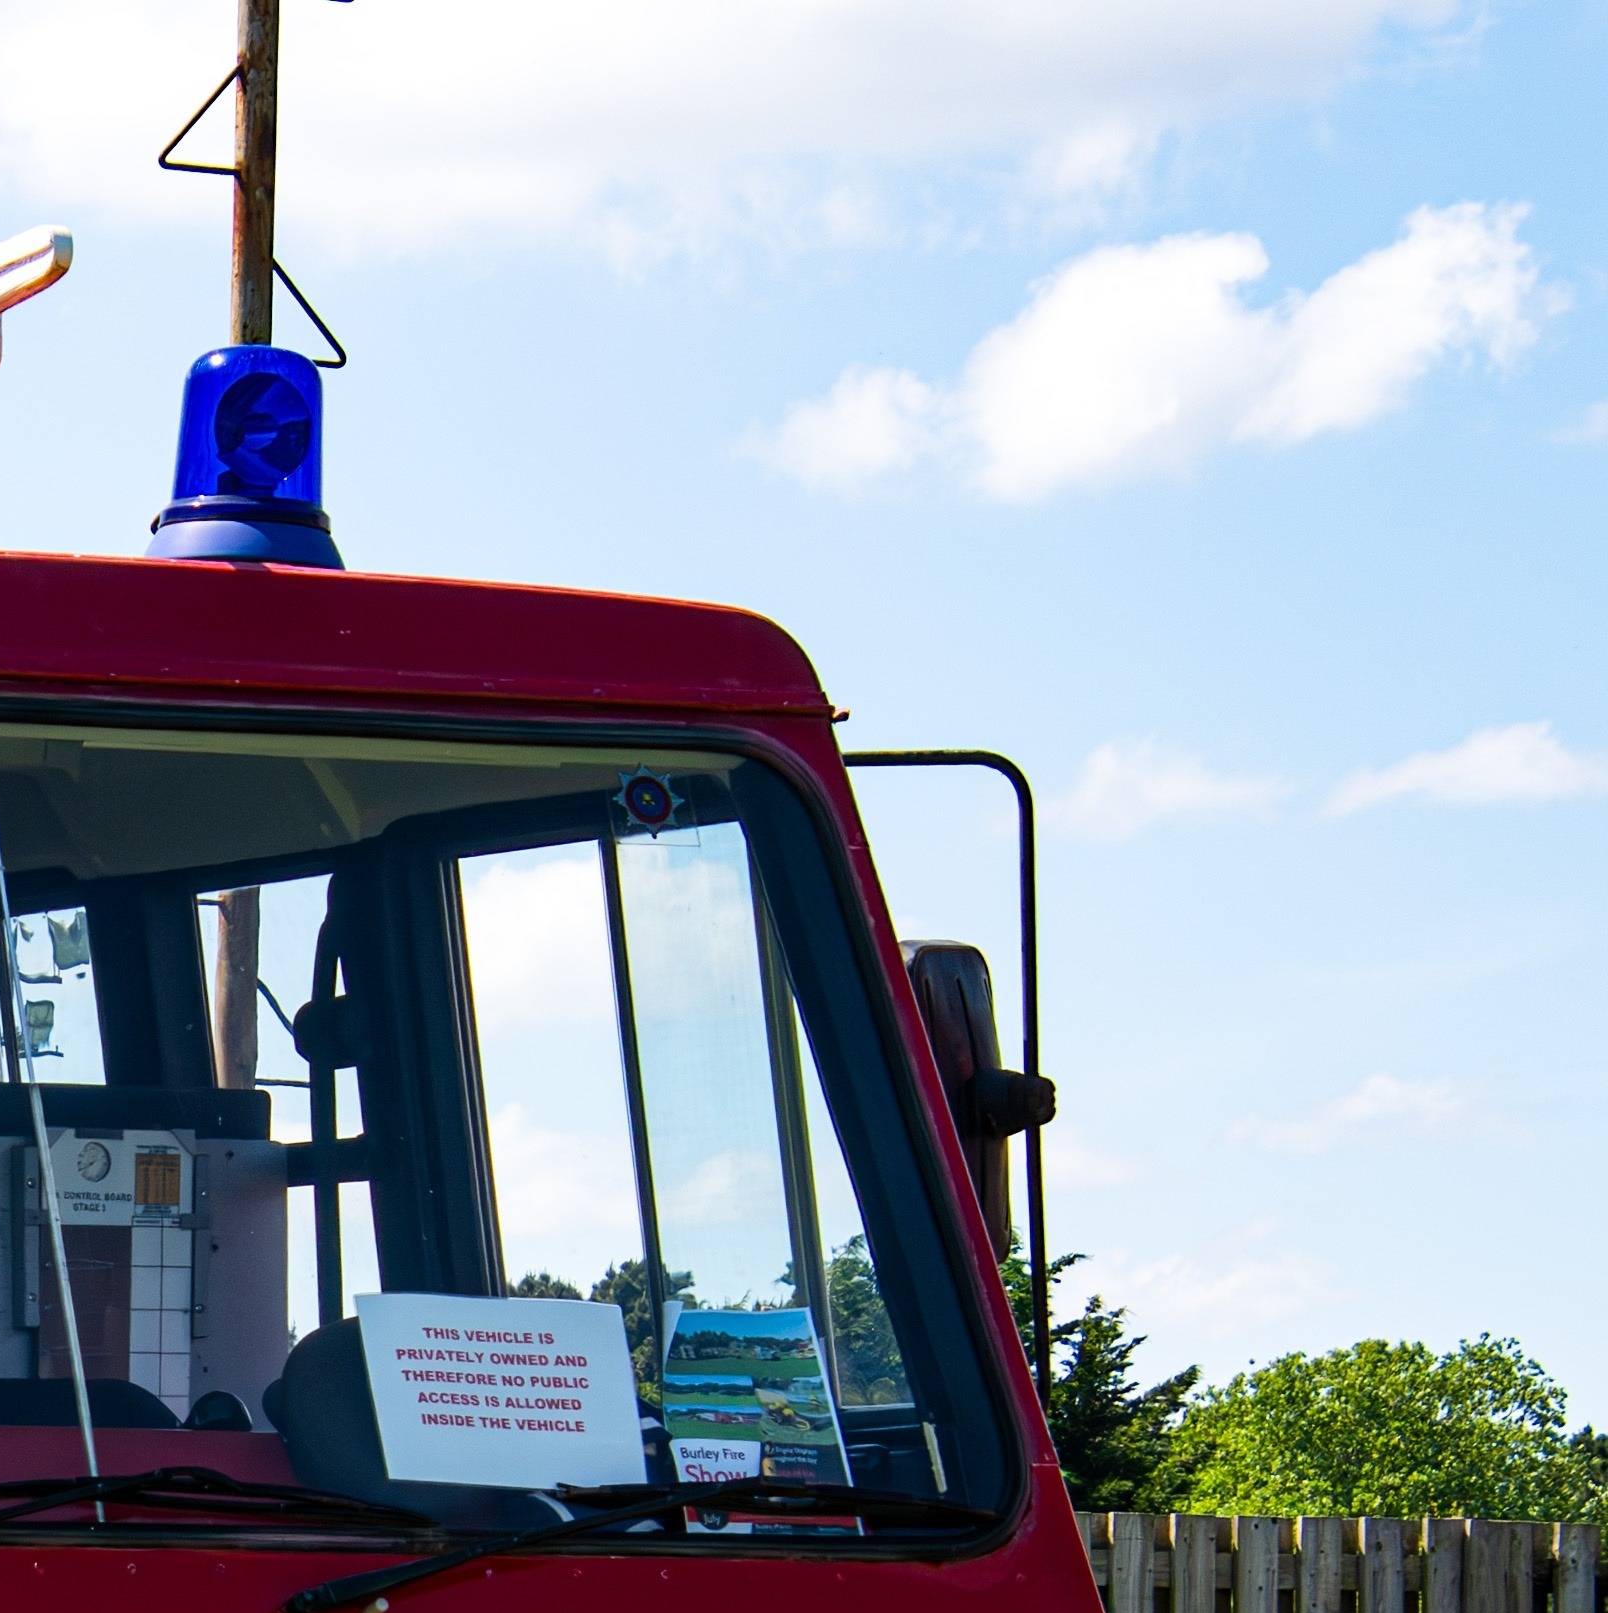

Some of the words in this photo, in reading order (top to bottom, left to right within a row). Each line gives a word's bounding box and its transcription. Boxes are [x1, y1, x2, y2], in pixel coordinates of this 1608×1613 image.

[104, 1192, 133, 1202] BOARD
[422, 1327, 460, 1341] THIS
[464, 1329, 533, 1344] VEHICLE
[539, 1332, 555, 1344] IS
[396, 1348, 484, 1363] PRIVATELY
[489, 1353, 549, 1366] OWNED
[554, 1355, 588, 1368] AND
[401, 1369, 497, 1386] THEREFORE
[501, 1375, 525, 1387] NO
[530, 1376, 589, 1389] PUBLIC
[418, 1392, 480, 1406] ACCESS
[485, 1395, 500, 1407] IS
[505, 1397, 582, 1411] ALLOWED
[421, 1413, 475, 1427] INSIDE
[478, 1416, 511, 1430] THE
[515, 1418, 585, 1433] VEHICLE
[680, 1446, 720, 1463] Burley
[722, 1448, 746, 1460] Fire
[684, 1464, 748, 1483] Show
[703, 1512, 721, 1526] July
